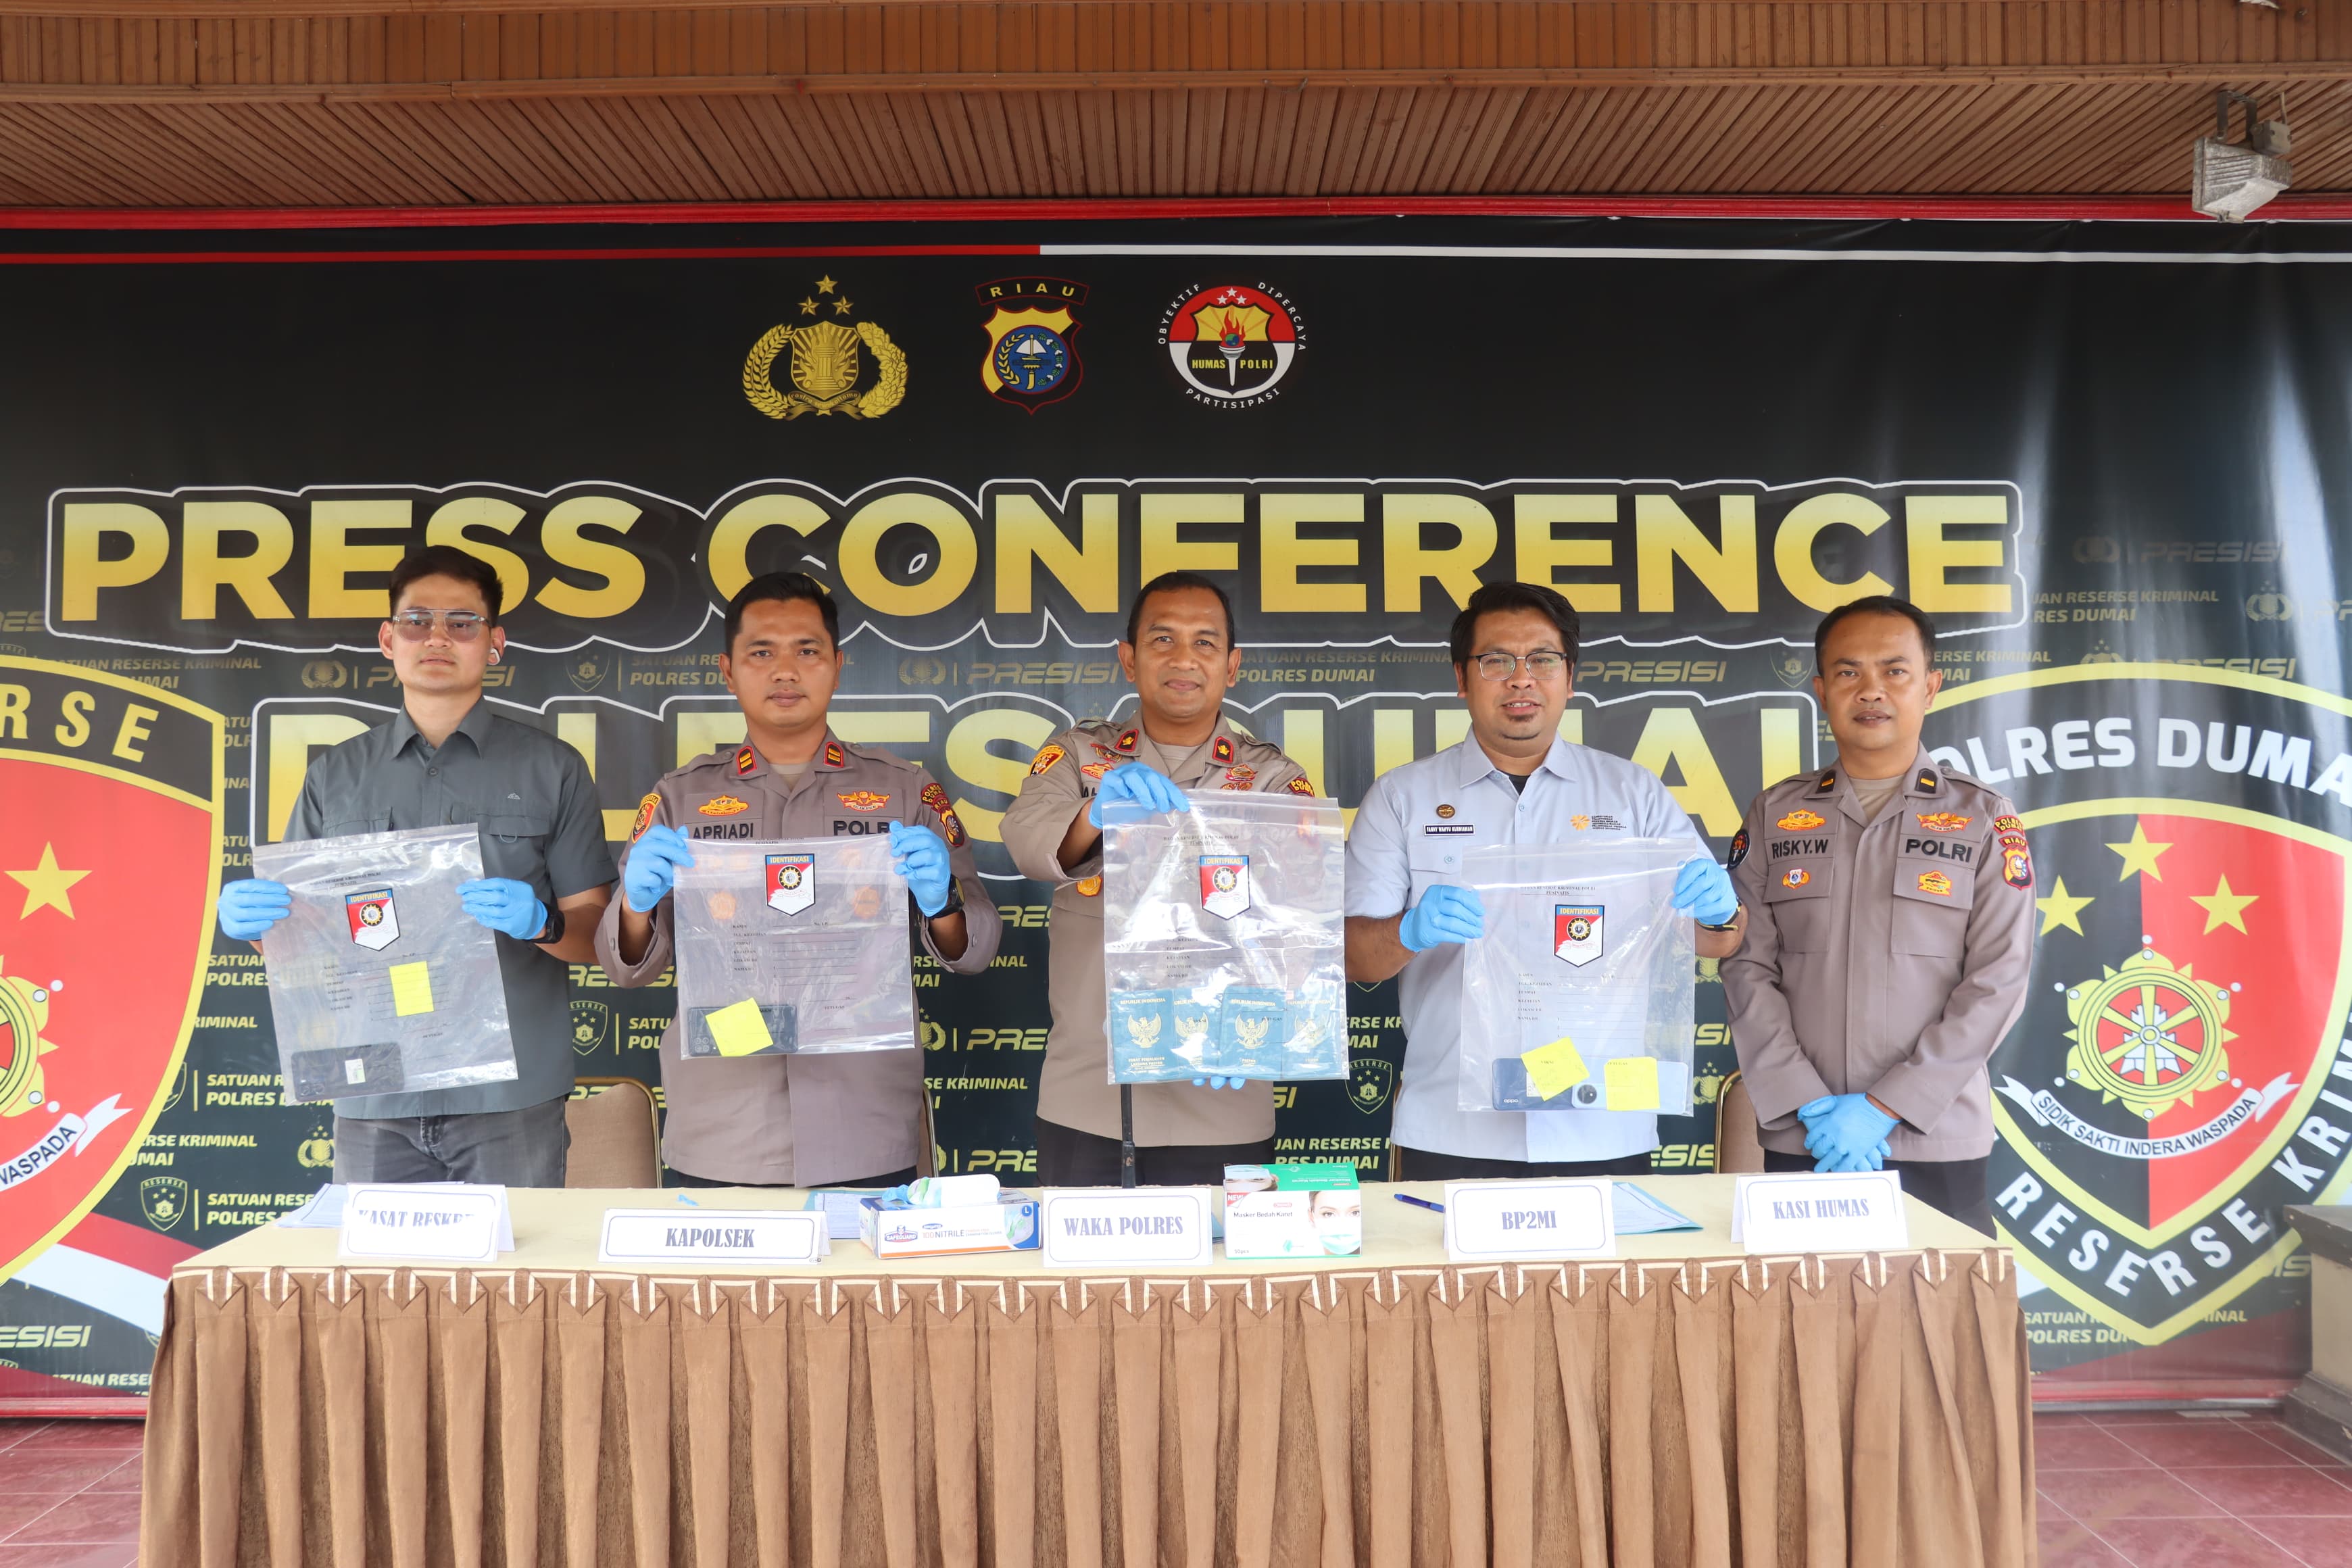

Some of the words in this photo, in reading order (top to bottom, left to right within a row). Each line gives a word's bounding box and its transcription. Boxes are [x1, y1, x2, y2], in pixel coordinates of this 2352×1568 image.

[989, 281, 1075, 298] RIAU
[1158, 283, 1200, 345] OBYEKTIF
[1258, 282, 1306, 351] DIPERCAYA
[1192, 360, 1226, 369] HUMAS
[1240, 360, 1273, 369] POLRI
[1185, 388, 1280, 410] PARTISIPASI
[62, 496, 645, 621] PRESS
[708, 493, 2013, 616] CONFERENCE
[2141, 541, 2283, 563] PRESIS
[2065, 591, 2136, 604] RESERSE
[2140, 590, 2220, 602] KRIMINAL
[2033, 610, 2068, 623] RES
[2072, 608, 2136, 622] DUMAI
[1305, 651, 1377, 662] RESERSE
[1381, 651, 1452, 662] KRIMINA
[1934, 651, 1972, 662] ERSE
[1976, 650, 2052, 662] KRIMINAL
[112, 658, 182, 670] RESERSE
[185, 658, 262, 669] KRIMINAL
[630, 672, 700, 685] POLRES
[967, 662, 1120, 685] PRESISI
[1236, 669, 1307, 682] POLRES
[1311, 669, 1375, 682] DUMAI
[1576, 661, 1727, 683] PRESISI
[1942, 668, 1971, 681] MAI
[135, 676, 179, 689] UMAI
[0, 684, 160, 763] RSE
[2157, 718, 2352, 806] DUMA
[693, 823, 754, 839] APRIADI
[833, 820, 889, 836] POLR
[1771, 838, 1829, 859] RISKY.W
[2004, 837, 2026, 846] RIAU
[1905, 839, 1973, 862] POLRI
[351, 891, 388, 902] IDENTIFIKASI
[570, 1001, 606, 1012] ESERSE
[194, 1016, 258, 1028] RIMINAL
[629, 1017, 672, 1029] SATU
[1348, 1035, 1379, 1048] MAI
[207, 1075, 278, 1087] SATUAN
[947, 1077, 1028, 1090] KRIMINAL
[206, 1092, 276, 1106] POLRES
[2038, 1096, 2076, 1131] SIDIK
[2074, 1125, 2121, 1153] SAKTI
[2124, 1140, 2186, 1156] INDERA
[2186, 1098, 2257, 1148] WASPADA
[178, 1135, 258, 1147] KRIMINAL
[1275, 1138, 1307, 1150] UAN
[1309, 1137, 1381, 1150] RESERSE
[144, 1177, 184, 1188] RESERSE
[207, 1193, 272, 1206] SATUAN
[274, 1193, 315, 1206] RESE
[1772, 1200, 1811, 1220] KASI
[1815, 1198, 1869, 1218] HUMAS
[206, 1210, 276, 1225] POLRES
[1500, 1210, 1558, 1230] BP2MI
[1064, 1216, 1114, 1237] WAKA
[1119, 1215, 1184, 1235] POLRES
[664, 1227, 756, 1249] KAPOLSEK
[935, 1229, 964, 1238] NITRILE
[1995, 1171, 2272, 1296] RESERSE
[0, 1325, 92, 1348] ESISI
[107, 1373, 151, 1386] RESE
